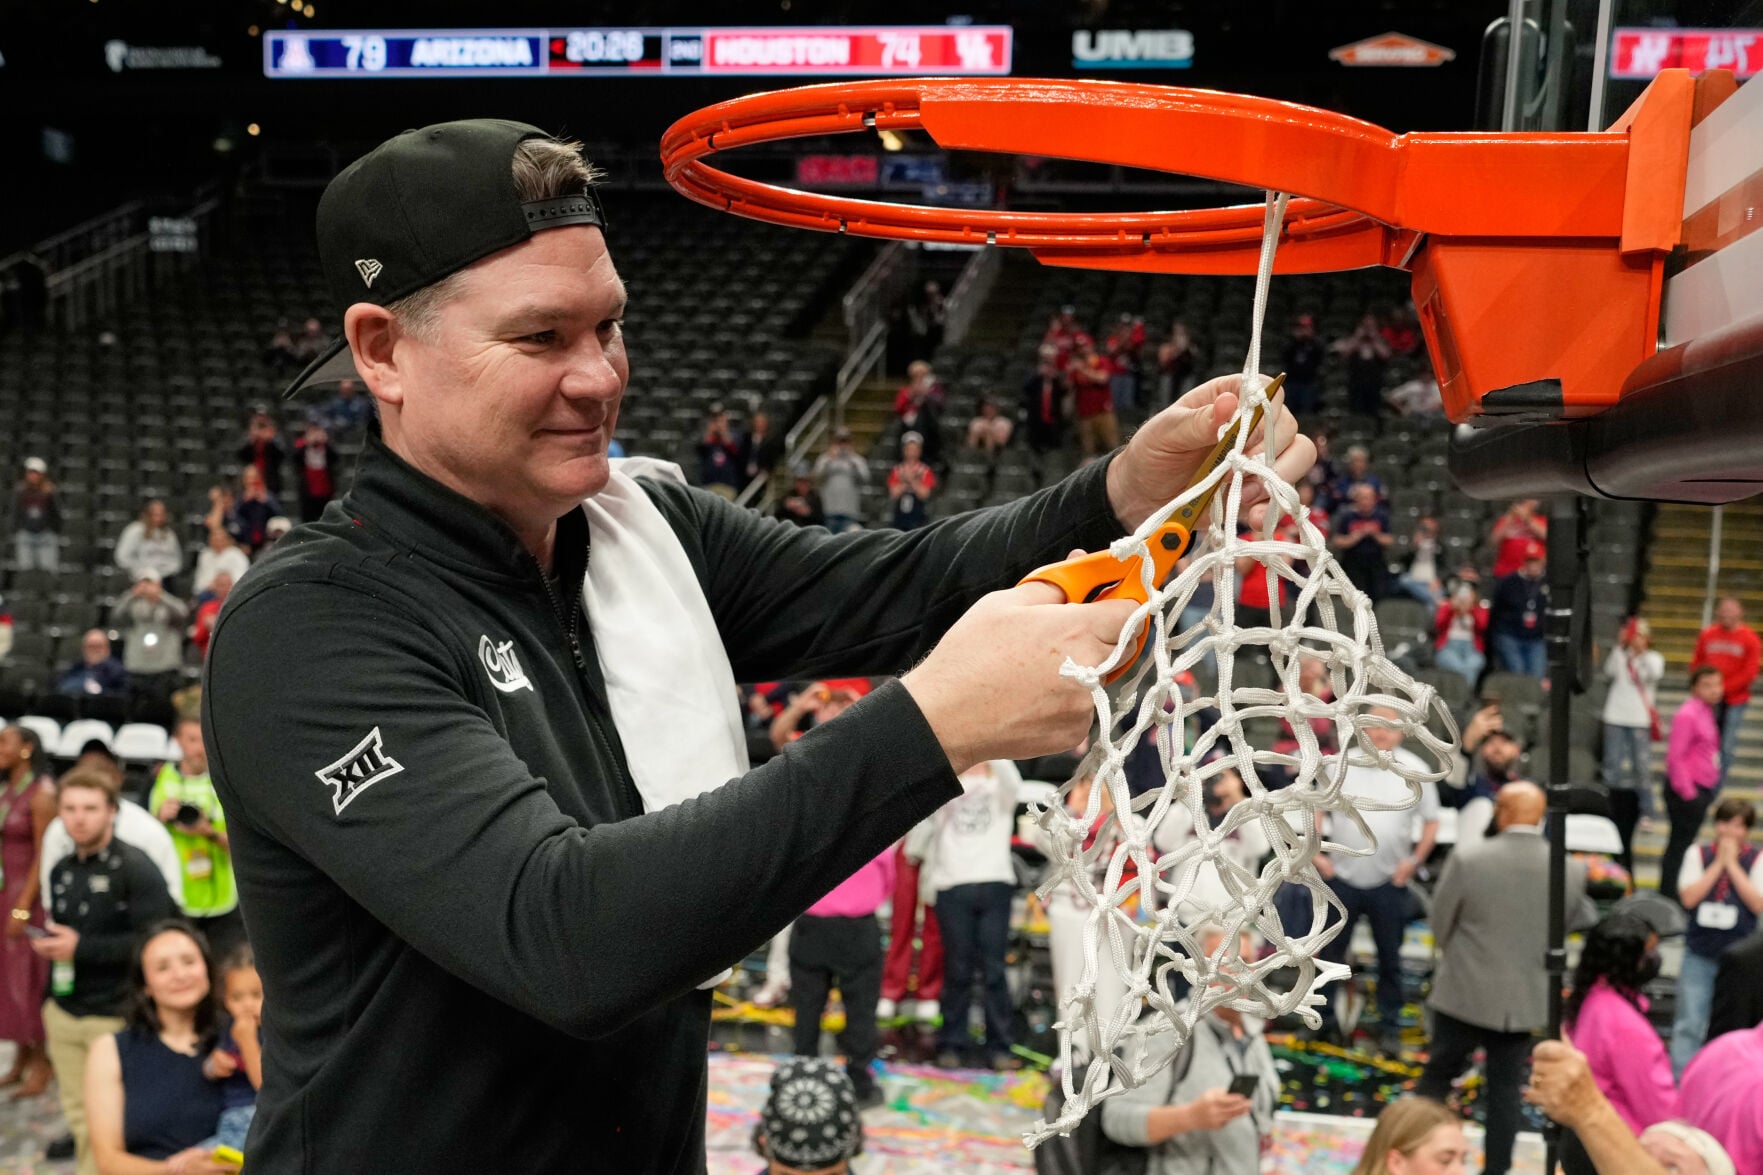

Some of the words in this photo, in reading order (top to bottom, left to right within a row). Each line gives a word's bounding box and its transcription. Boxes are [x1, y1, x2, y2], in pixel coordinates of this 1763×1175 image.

[341, 35, 387, 71] 79
[410, 37, 533, 66] ARIZONA
[714, 36, 850, 65] HOUSTON
[877, 32, 920, 68] 74
[1072, 29, 1195, 60] UMB
[319, 731, 400, 811] XII
